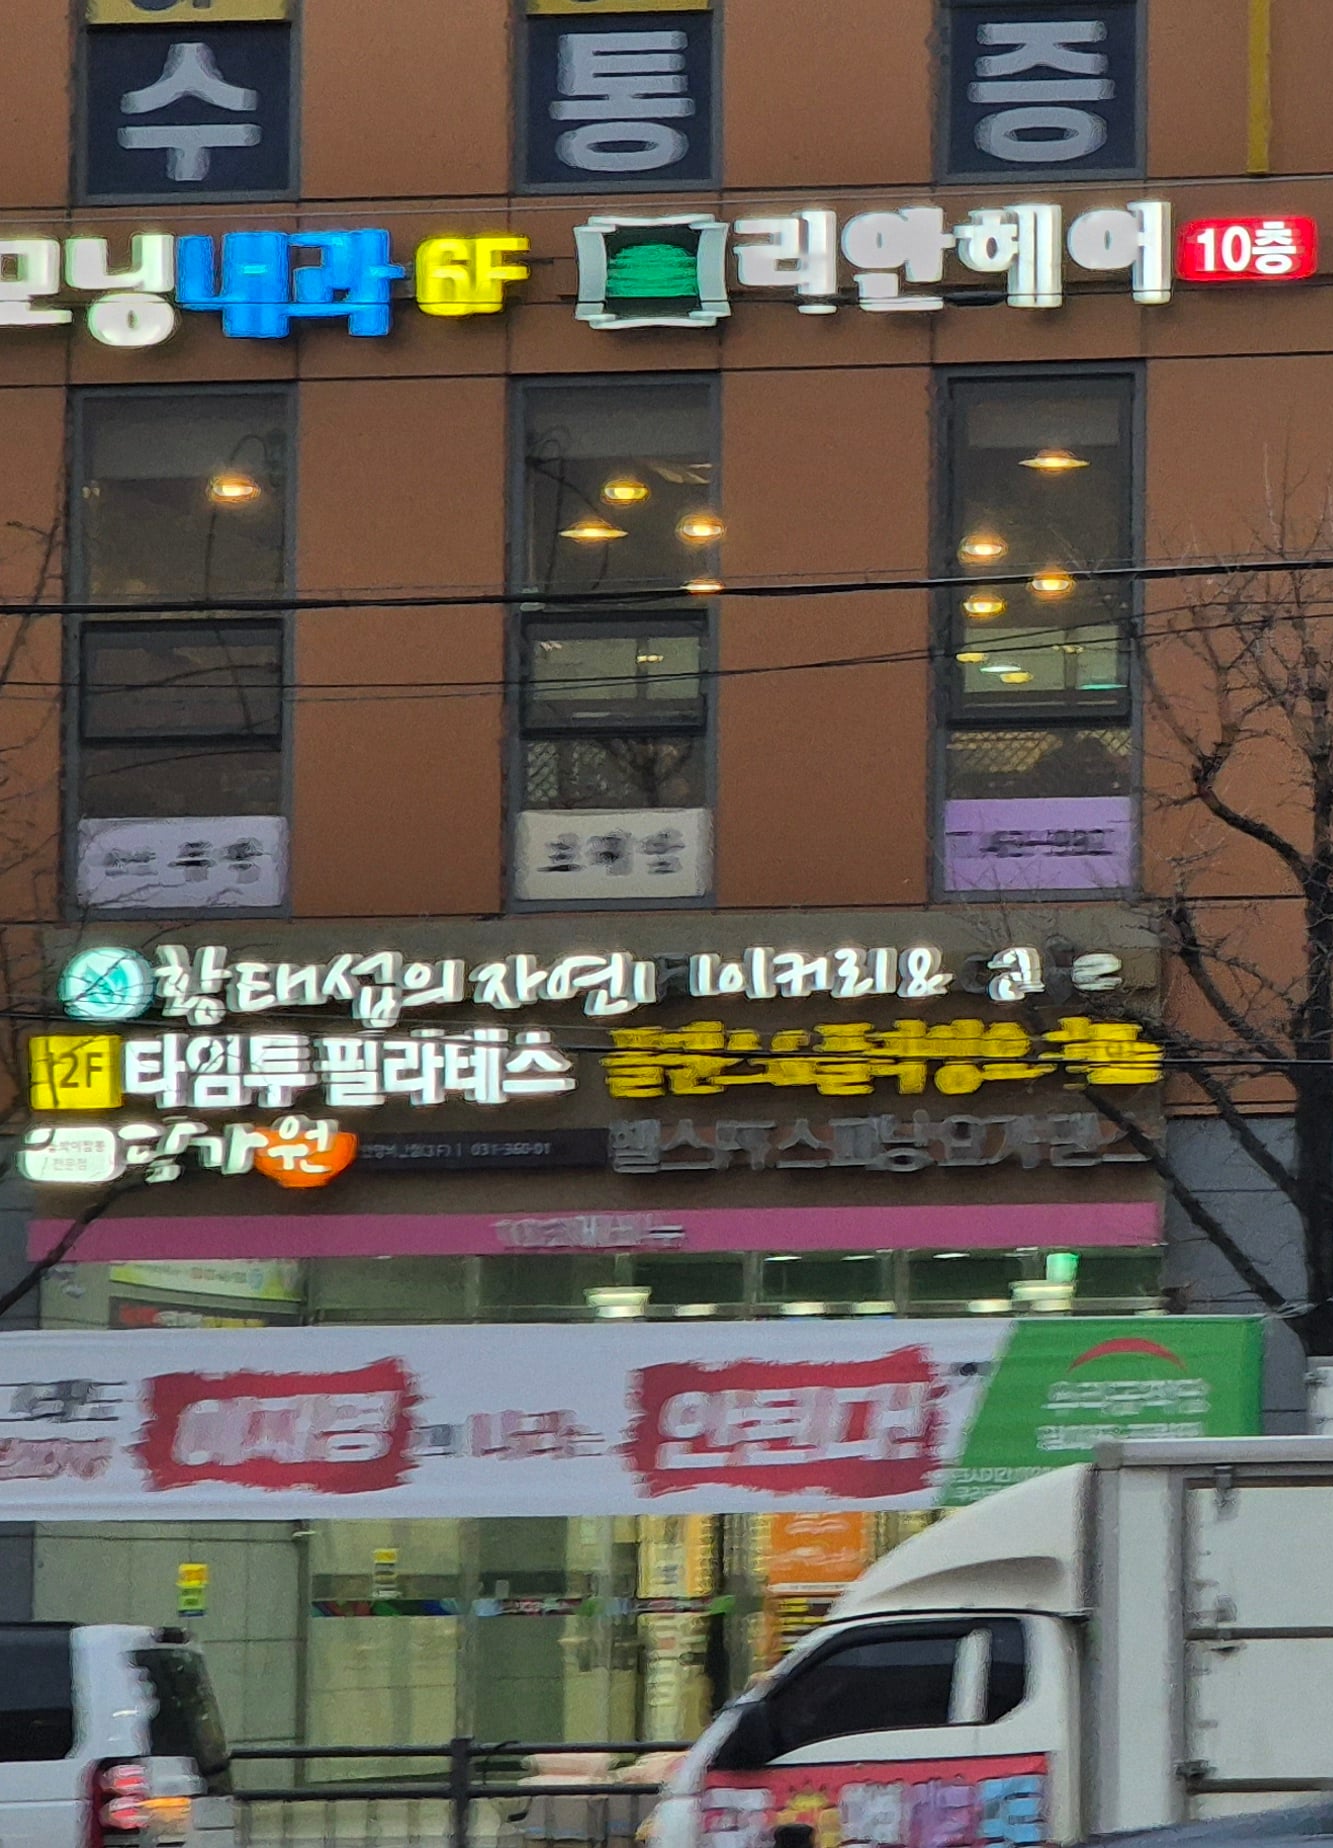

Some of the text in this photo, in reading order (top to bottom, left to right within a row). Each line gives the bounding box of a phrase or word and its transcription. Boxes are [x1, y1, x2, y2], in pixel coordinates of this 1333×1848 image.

[117, 42, 262, 181] 수
[548, 30, 696, 173] 통
[966, 19, 1116, 163] 증
[416, 236, 530, 316] 6F
[733, 201, 1298, 315] 리안헤어 10층
